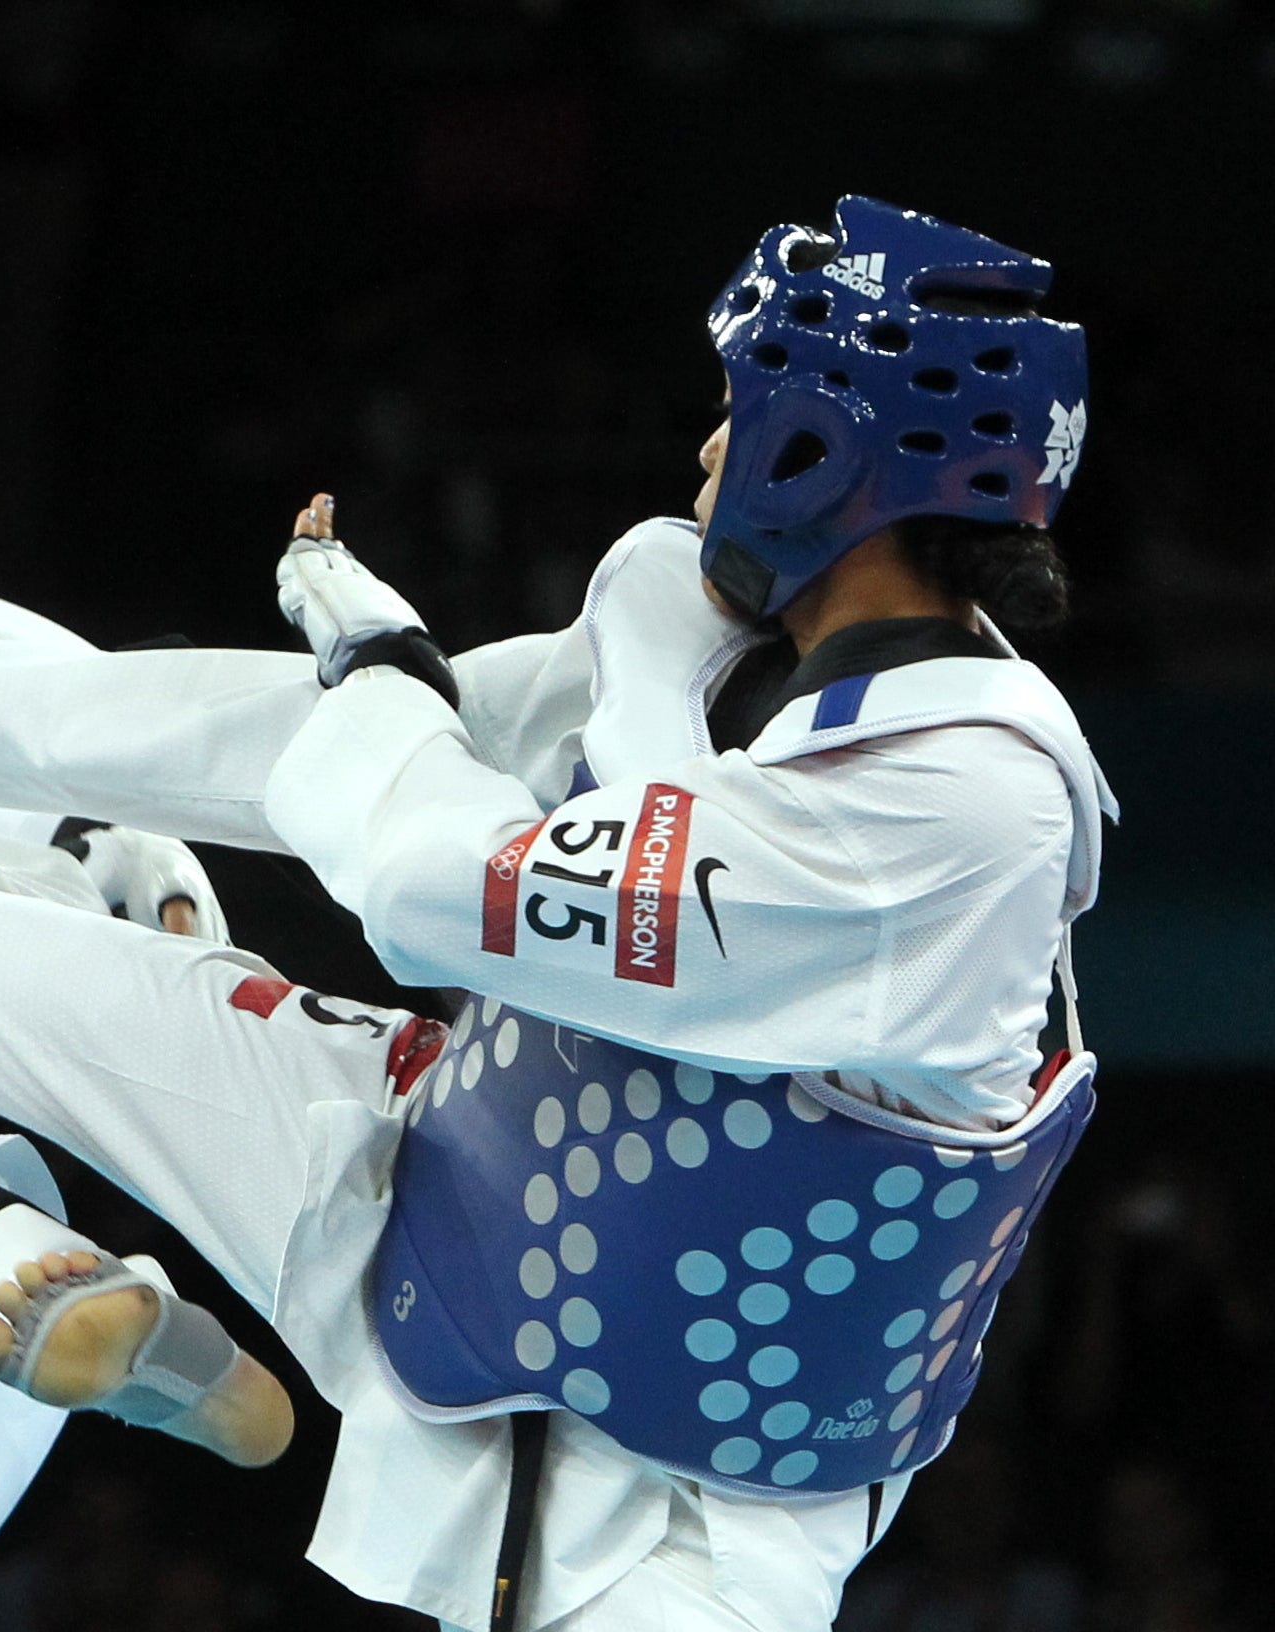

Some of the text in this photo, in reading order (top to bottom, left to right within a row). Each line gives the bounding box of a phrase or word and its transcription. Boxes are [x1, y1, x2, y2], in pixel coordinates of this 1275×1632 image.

[822, 263, 886, 300] adidas
[524, 820, 626, 947] 515
[629, 793, 678, 969] P.MCPHERSON
